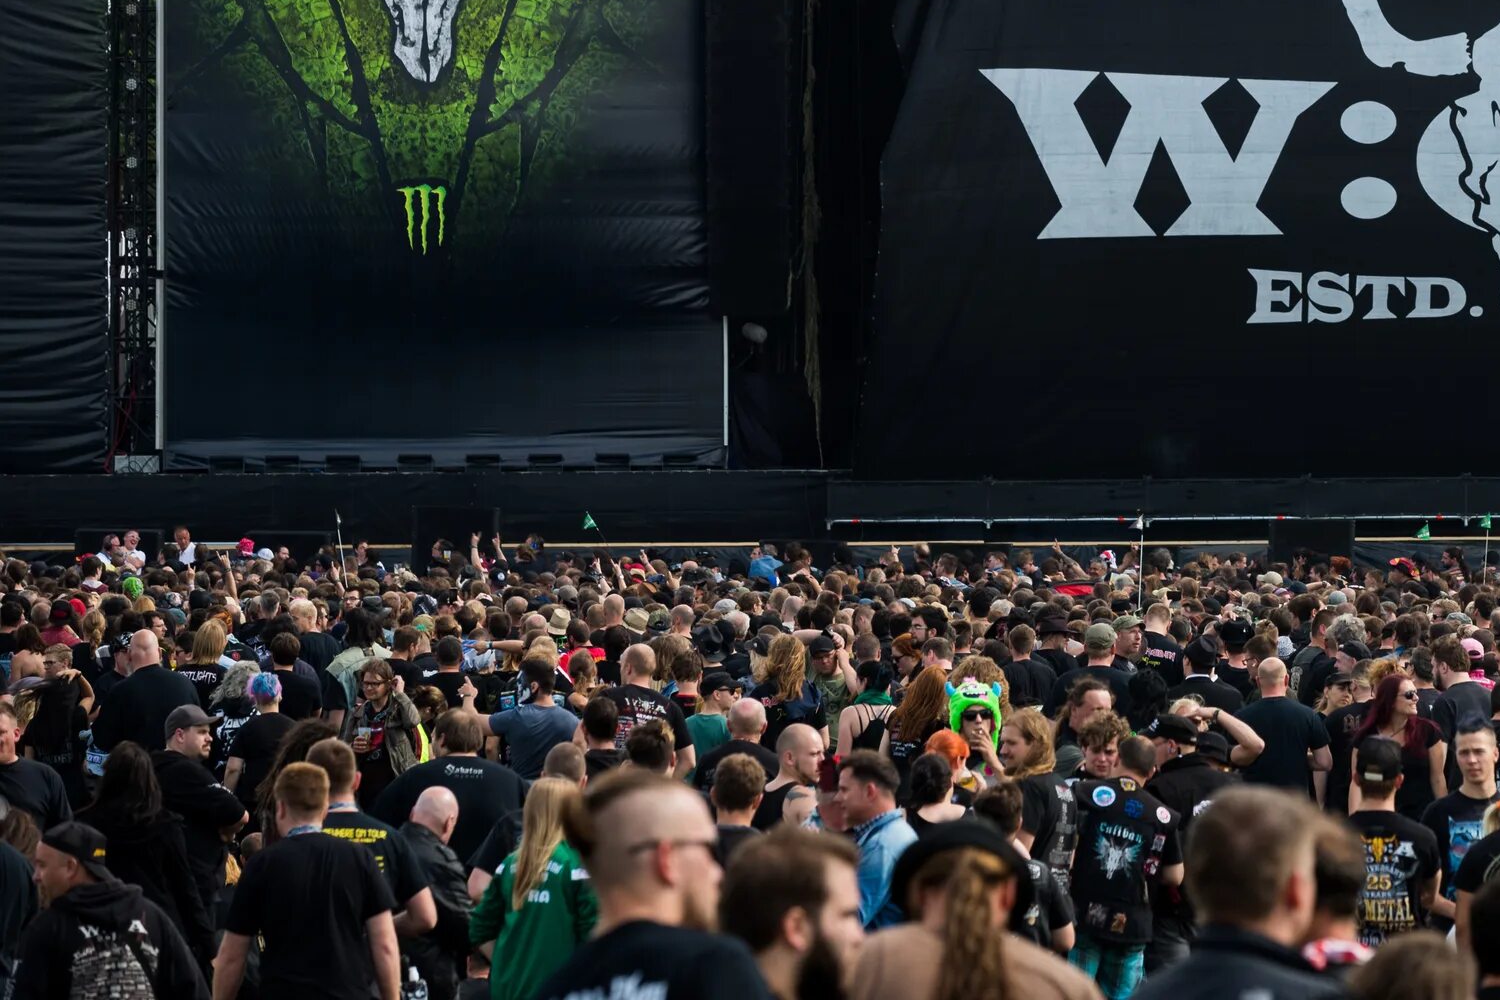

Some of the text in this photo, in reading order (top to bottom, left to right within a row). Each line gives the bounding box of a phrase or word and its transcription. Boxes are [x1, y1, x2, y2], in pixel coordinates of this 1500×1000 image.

[1246, 268, 1484, 324] ESTD.
[1366, 874, 1392, 891] 25
[1364, 897, 1415, 920] METAL
